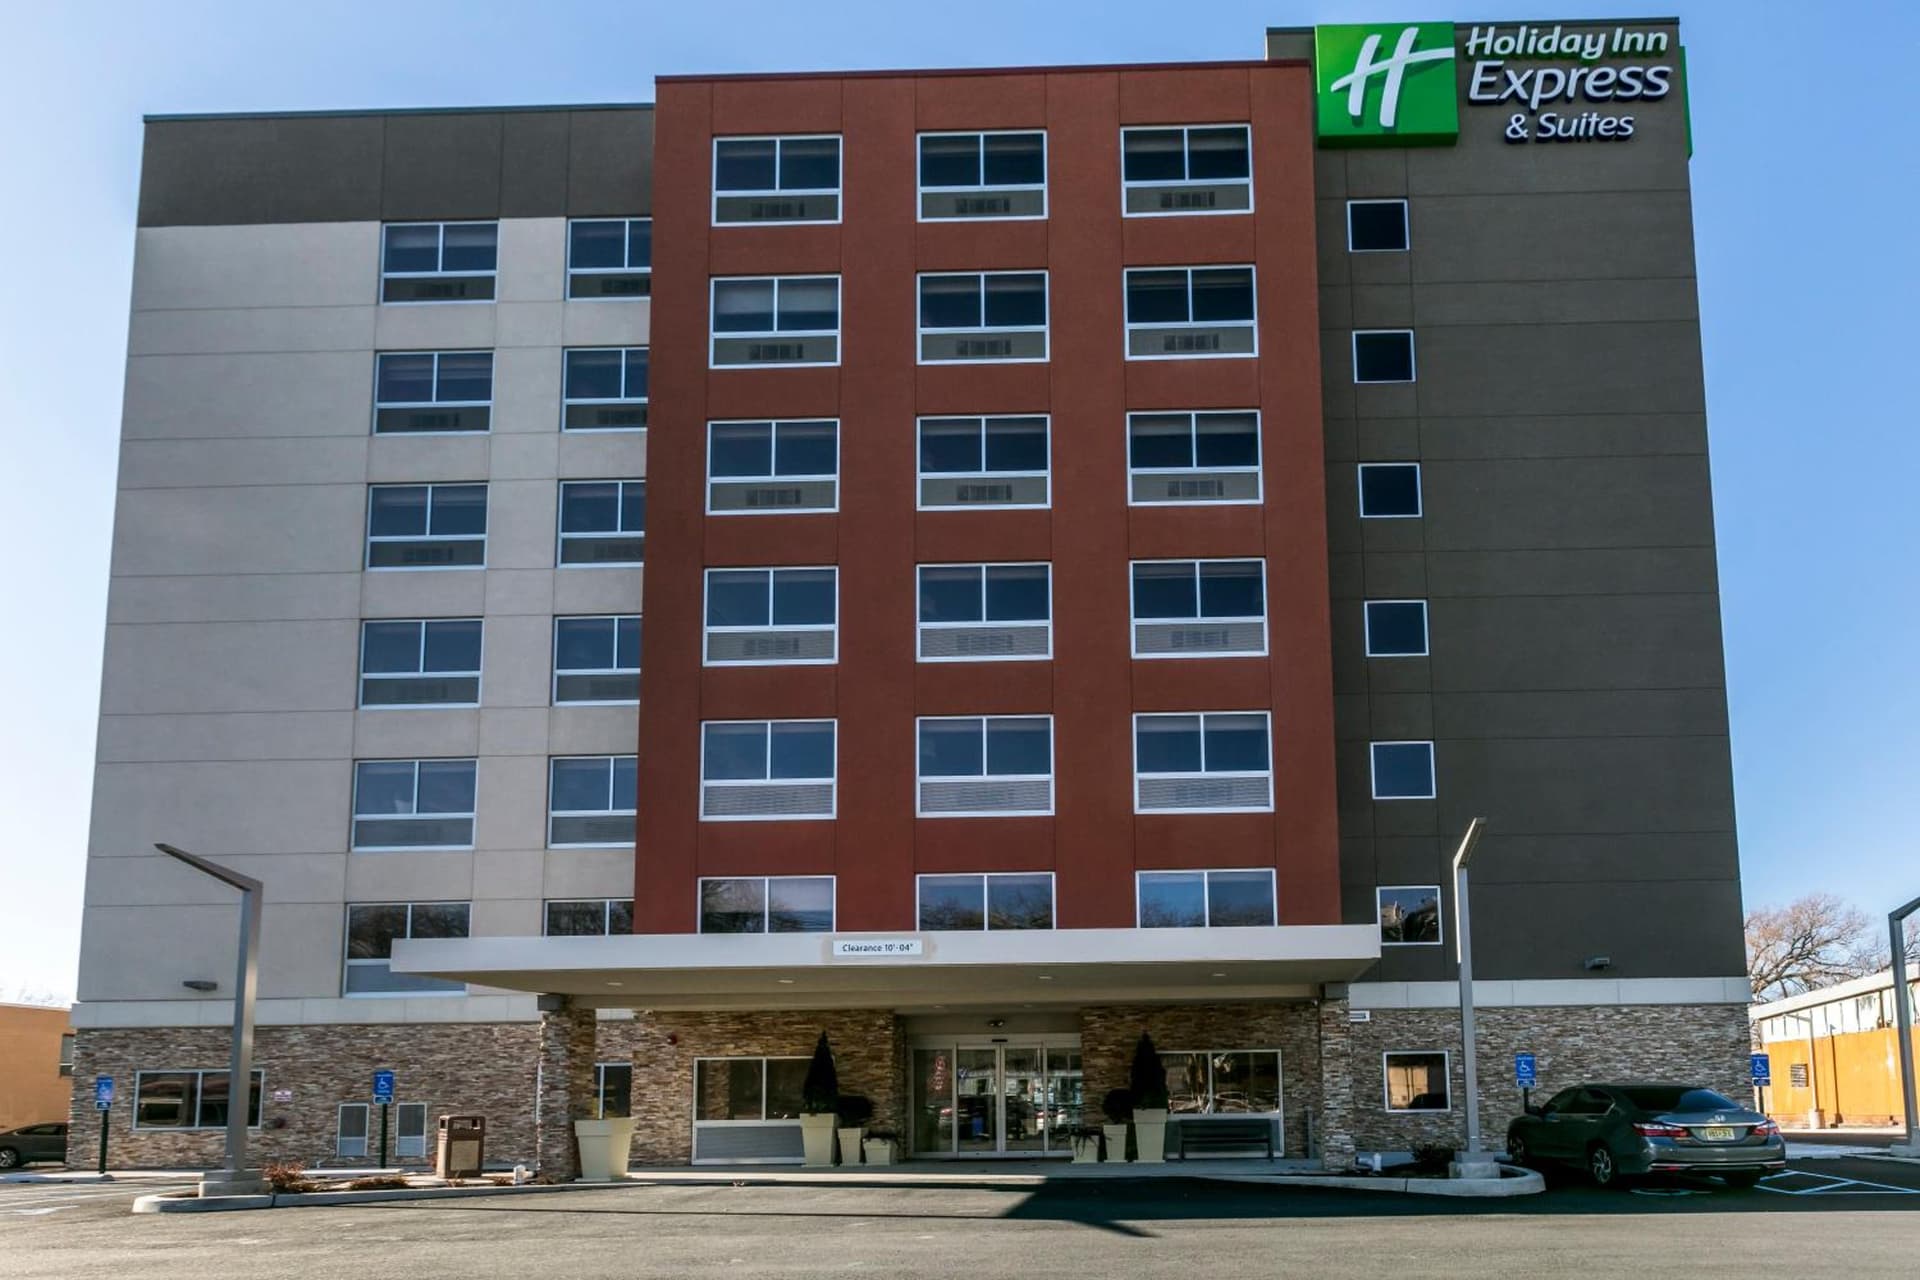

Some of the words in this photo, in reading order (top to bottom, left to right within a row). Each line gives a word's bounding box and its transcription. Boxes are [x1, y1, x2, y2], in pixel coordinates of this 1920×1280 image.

[1465, 26, 1607, 60] Holiday
[1611, 26, 1668, 53] Inn
[1331, 26, 1455, 128] H
[1468, 60, 1673, 110] Express
[1505, 113, 1529, 140] &
[1536, 112, 1635, 139] Suites
[842, 943, 882, 952] Clearance
